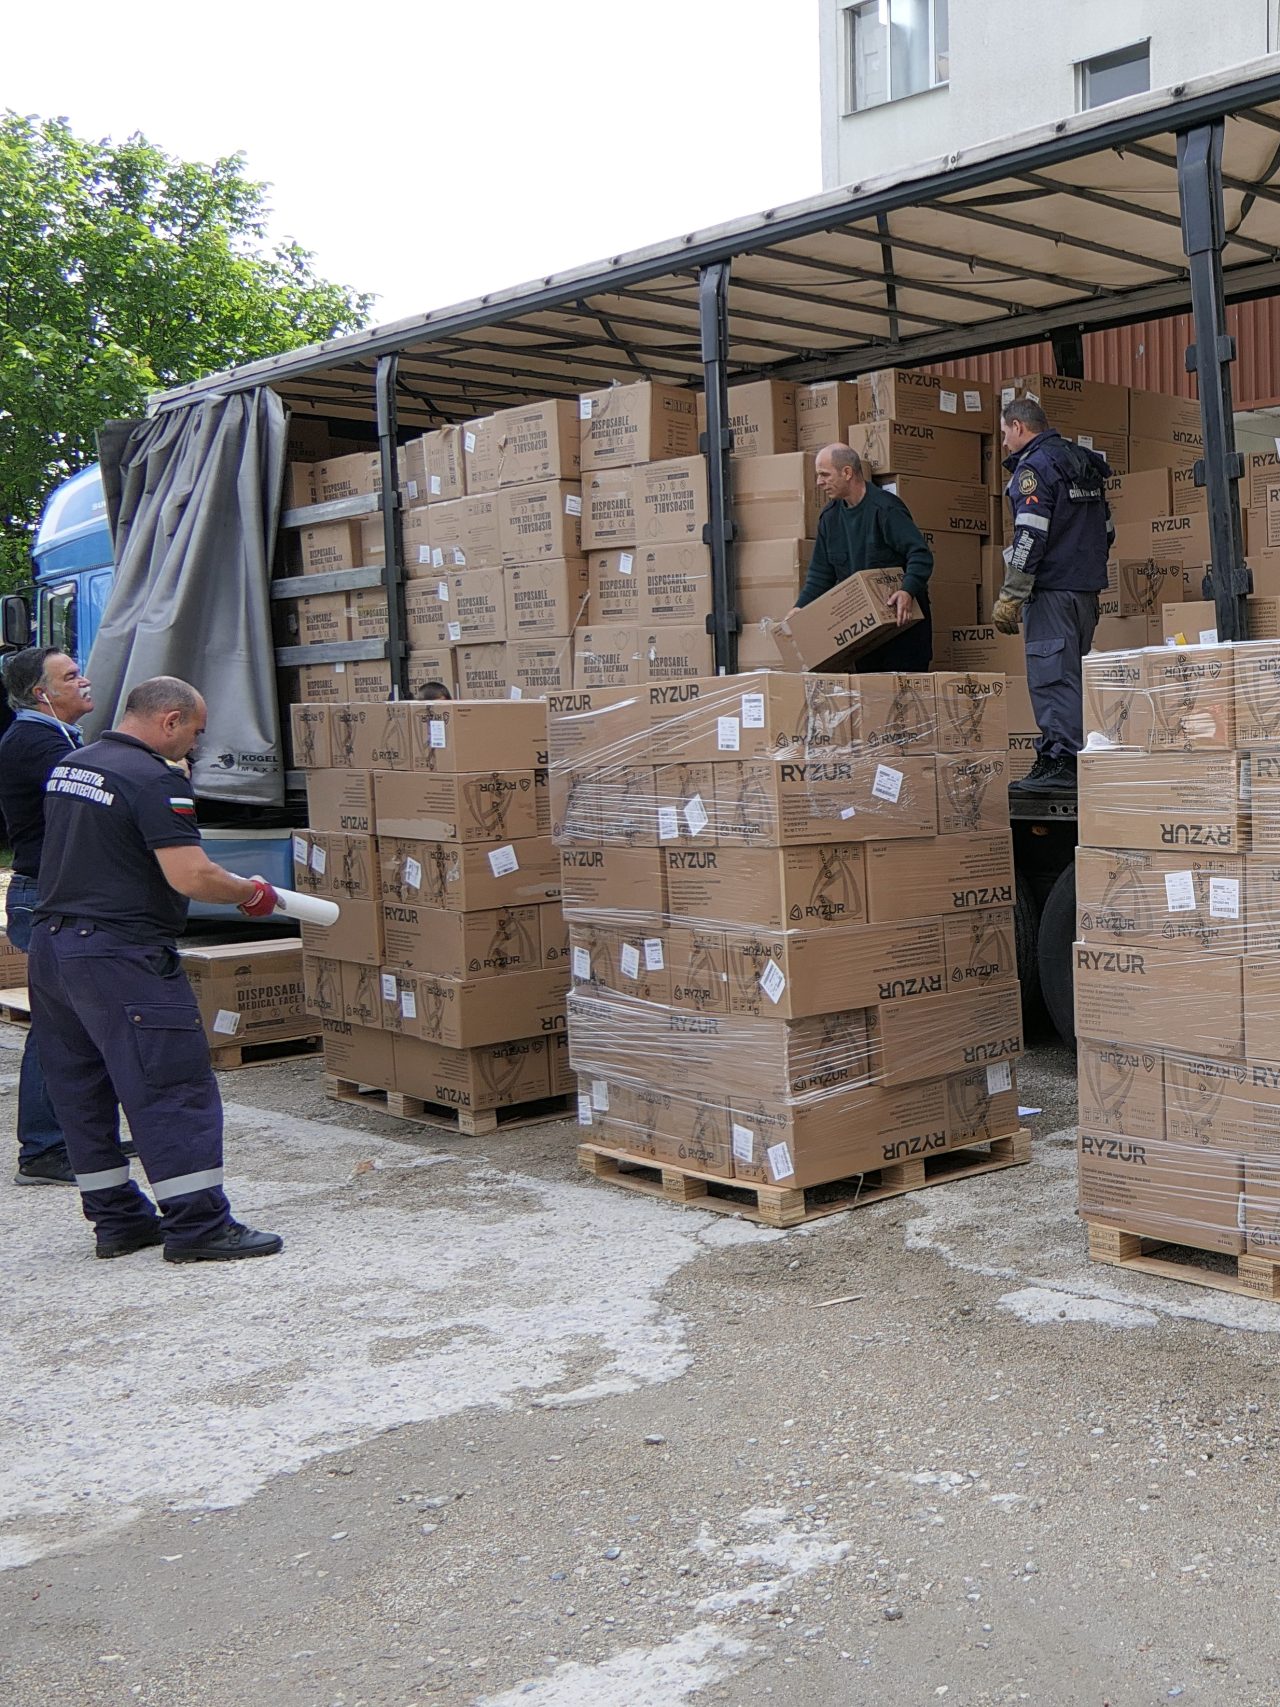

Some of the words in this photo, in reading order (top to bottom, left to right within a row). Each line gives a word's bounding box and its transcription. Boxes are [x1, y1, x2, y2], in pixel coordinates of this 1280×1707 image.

[898, 372, 941, 389] RYZUR
[1042, 376, 1083, 393] RYZUR
[592, 416, 630, 431] DISPOSABLE
[893, 423, 934, 440] RYZUR
[1174, 469, 1194, 482] RYZ
[592, 498, 631, 512] DISPOSABLE
[654, 499, 694, 514] DISPOSABLE
[949, 517, 988, 531] RYZUR
[1151, 518, 1191, 533] RYZUR
[647, 574, 687, 587] DISPOSABLE
[833, 613, 877, 648] RYZUR
[952, 629, 994, 642] RYZUR
[650, 684, 700, 704] RYZUR
[549, 694, 592, 712] RYZUR
[1009, 738, 1034, 750] RYZ
[781, 763, 851, 783] RYZUR
[57, 779, 115, 806] PROTECTION
[480, 781, 517, 792] RYZUR
[340, 815, 368, 830] RYZUR
[563, 852, 604, 867] RYZUR
[669, 852, 717, 869] RYZUR
[953, 886, 1012, 908] RYZUR
[385, 906, 419, 925] RYZUR
[804, 903, 845, 917] RYZUR
[483, 956, 521, 968] RYZUR
[1077, 950, 1146, 975] RYZUR
[965, 964, 999, 978] RYZUR
[684, 989, 711, 1000] RYZUR
[878, 974, 942, 999] RYZUR
[238, 999, 275, 1012] MEDICAL
[279, 995, 300, 1006] FACE
[322, 1019, 352, 1035] RYZUR
[963, 1036, 1020, 1063] RYZUR
[1100, 1052, 1139, 1068] RYZUR
[435, 1085, 471, 1106] RYZUR
[883, 1131, 946, 1161] RYZUR
[1082, 1136, 1148, 1166] RYZUR
